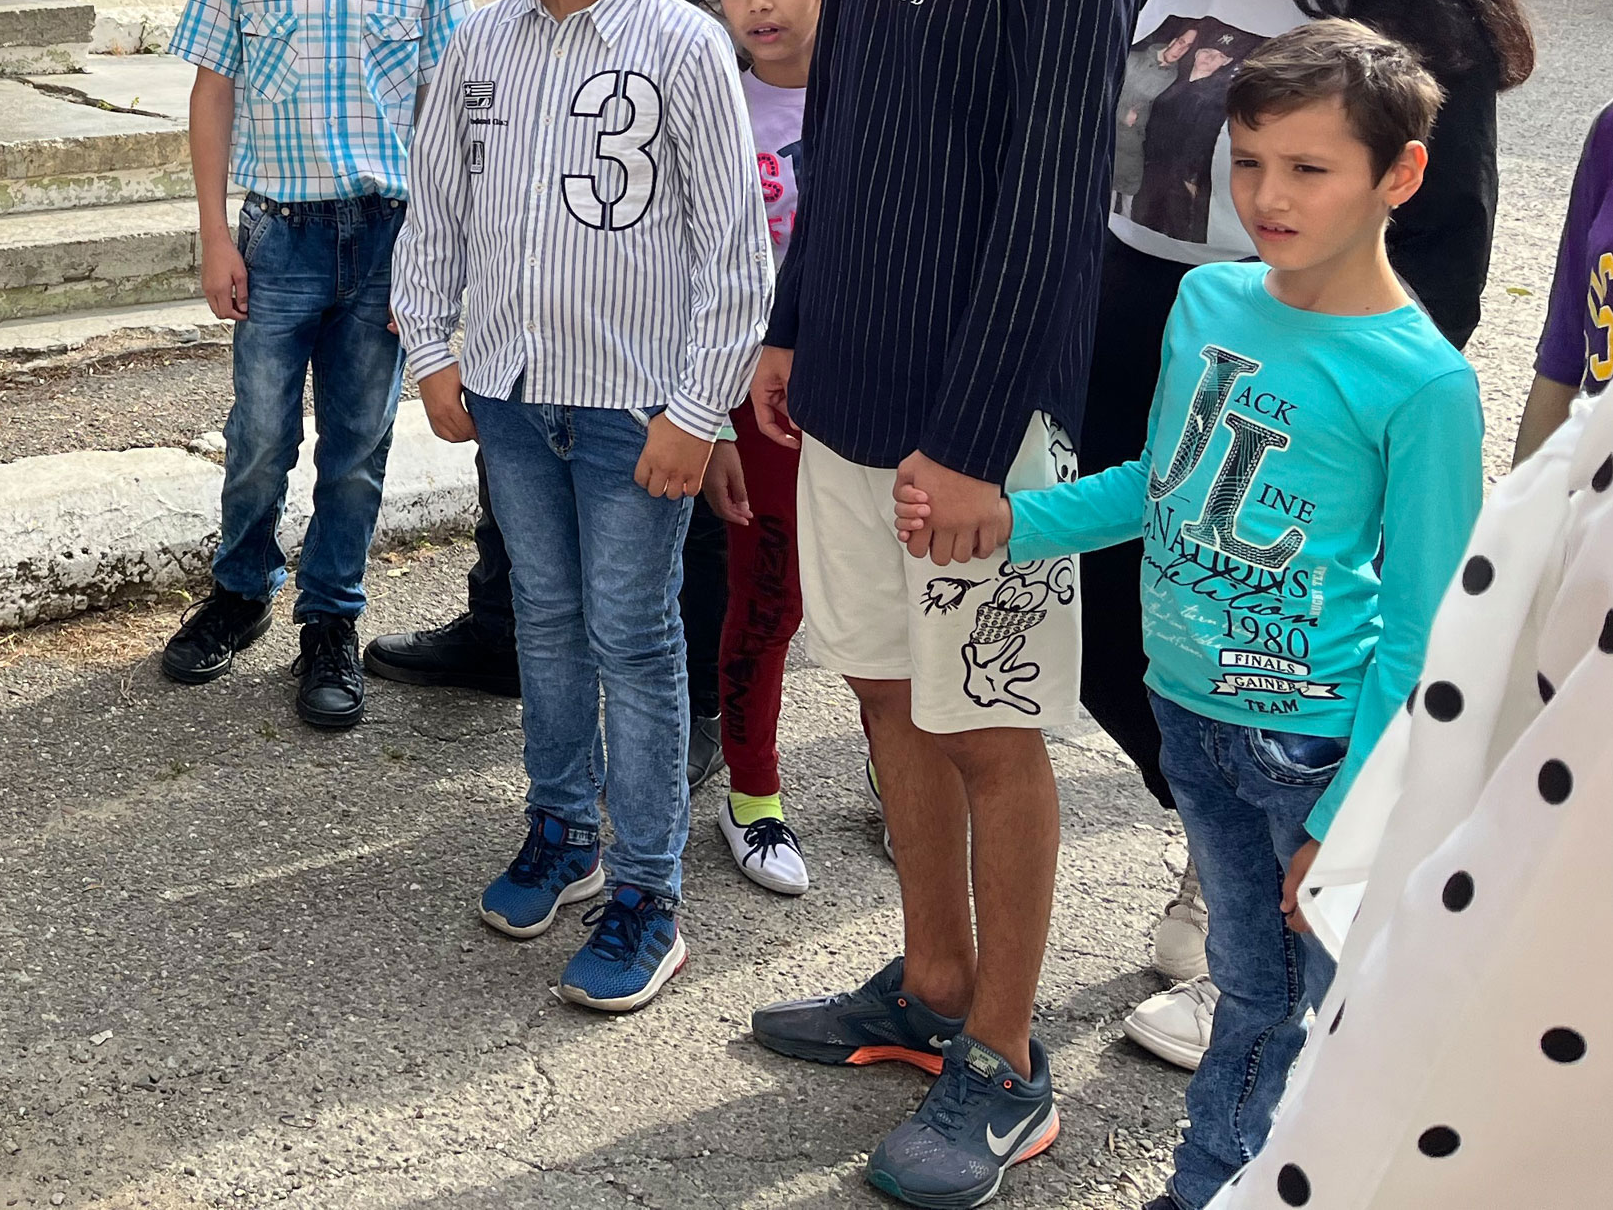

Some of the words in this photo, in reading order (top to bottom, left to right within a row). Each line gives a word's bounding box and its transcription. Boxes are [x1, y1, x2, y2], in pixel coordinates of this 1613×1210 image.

[561, 69, 663, 231] 3
[1221, 609, 1310, 660] 1980
[1234, 653, 1296, 675] FINALS
[1234, 676, 1297, 691] GAINER
[1243, 698, 1300, 714] TEAM
